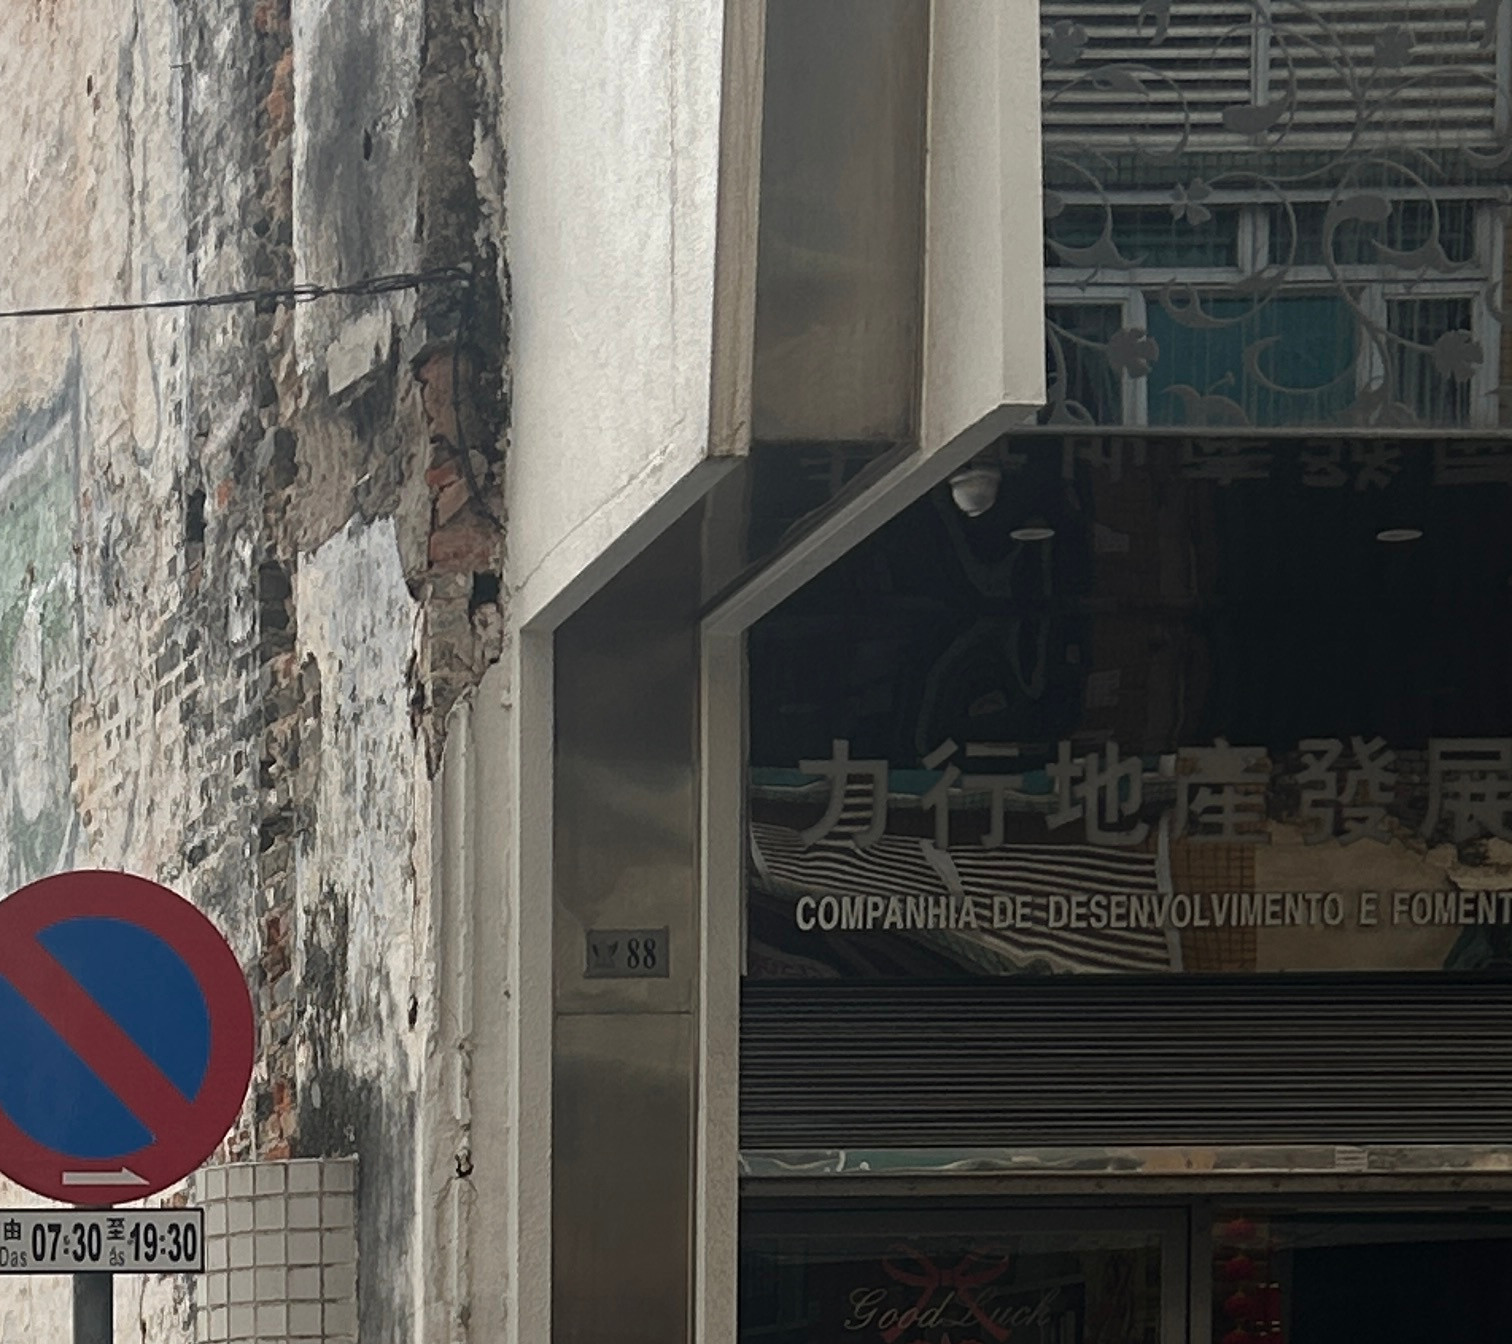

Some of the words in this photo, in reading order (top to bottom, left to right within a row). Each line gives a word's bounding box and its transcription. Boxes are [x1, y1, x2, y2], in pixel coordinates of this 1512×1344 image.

[797, 737, 1512, 850] 力行地產發展
[795, 892, 978, 932] COMPANHIA
[992, 893, 1033, 930] DE
[1046, 890, 1344, 930] DESENVOLVIMENTO
[1359, 891, 1378, 926] E
[627, 937, 657, 970] 88
[3, 1218, 22, 1241] 由
[31, 1222, 102, 1263] 07:30
[106, 1217, 126, 1241] 至
[129, 1221, 197, 1263] 19:30
[843, 1286, 955, 1331] Good
[949, 1286, 1062, 1329] Luck
